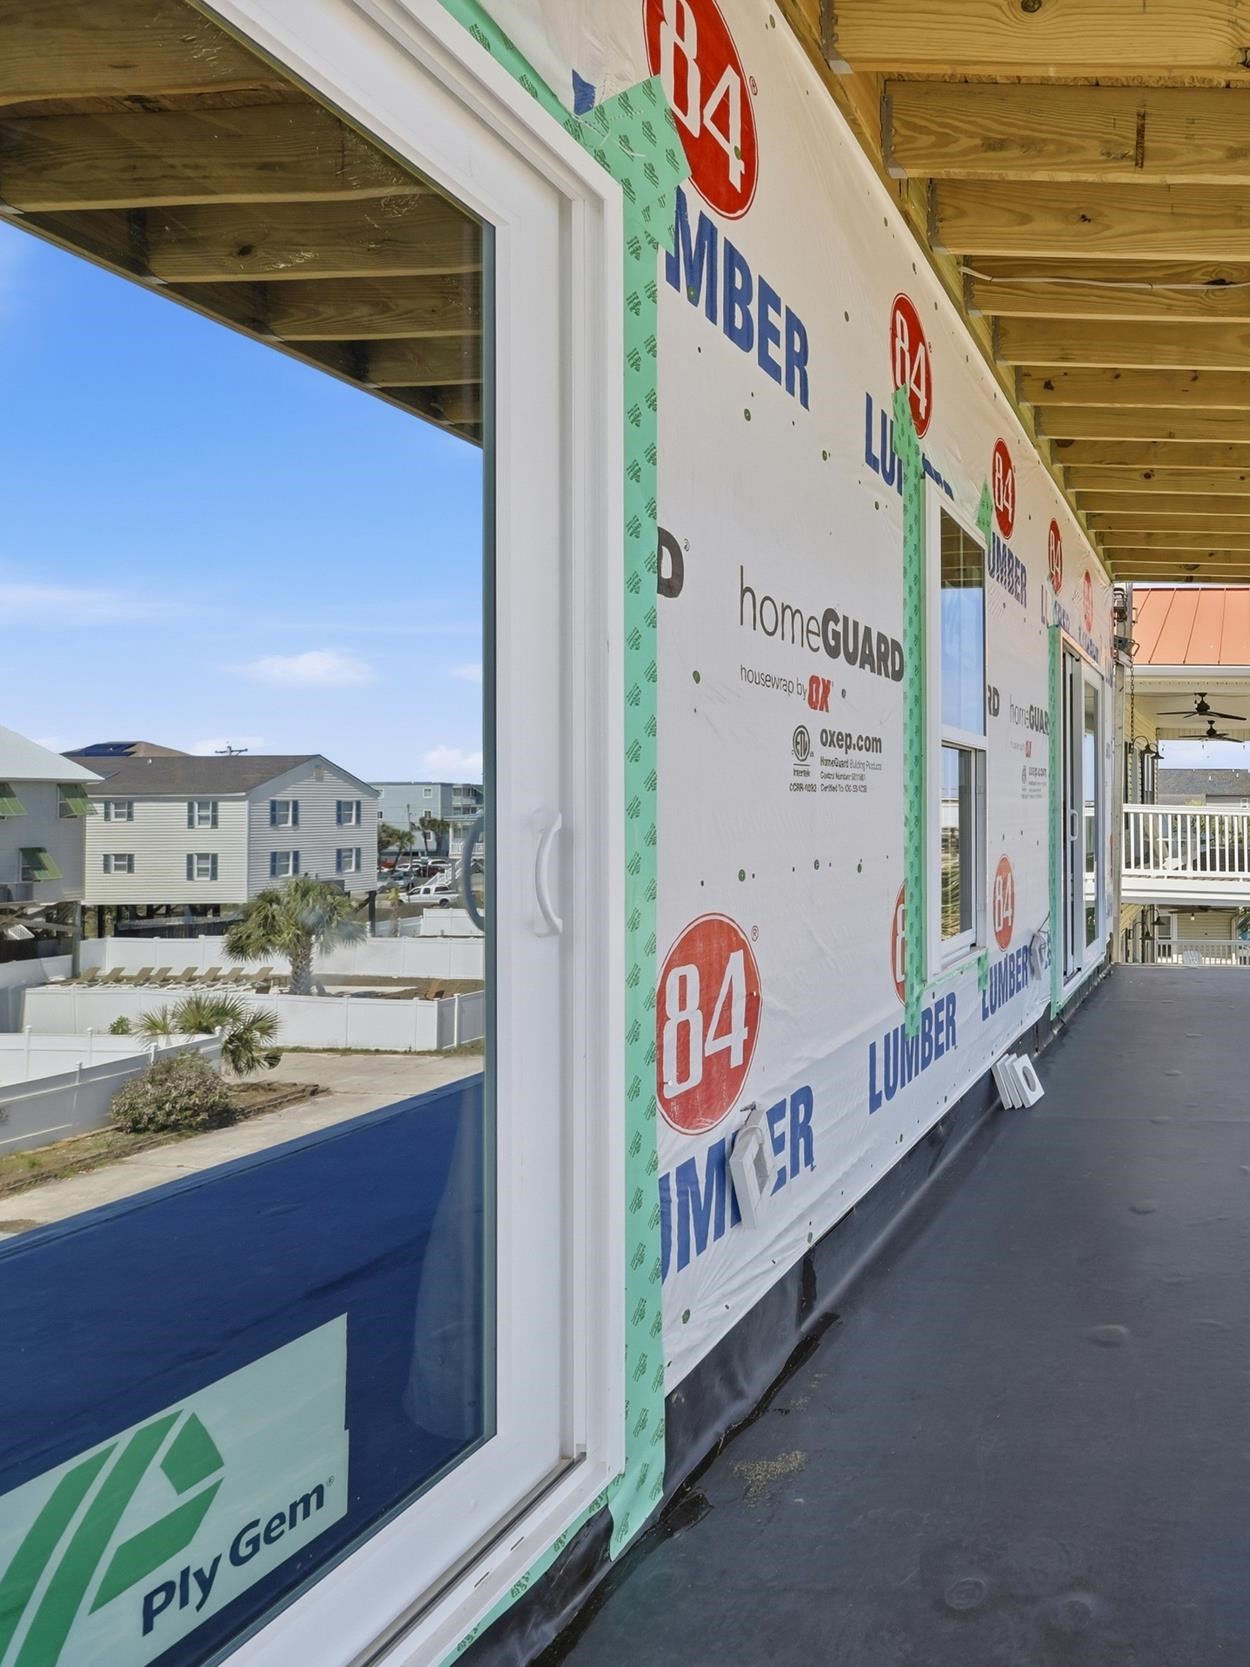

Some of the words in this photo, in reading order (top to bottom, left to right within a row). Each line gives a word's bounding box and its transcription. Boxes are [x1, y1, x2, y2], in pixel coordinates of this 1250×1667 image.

[660, 0, 746, 194] 84
[665, 184, 810, 412] MBER
[895, 309, 928, 420] 84
[994, 451, 1014, 523] 84
[987, 531, 1028, 609] UMBER
[740, 564, 905, 683] homeGUARD
[740, 664, 795, 696] housewrap
[796, 677, 808, 701] by
[808, 675, 832, 713] OX
[1009, 694, 1049, 736] homeGUAR
[820, 728, 882, 755] oxep.com
[995, 873, 1012, 931] 84
[663, 949, 749, 1099] 84
[982, 945, 1029, 1022] LUMBER
[869, 991, 957, 1115] LUMBER
[142, 1553, 223, 1637] Ply
[229, 1483, 325, 1567] Gem
